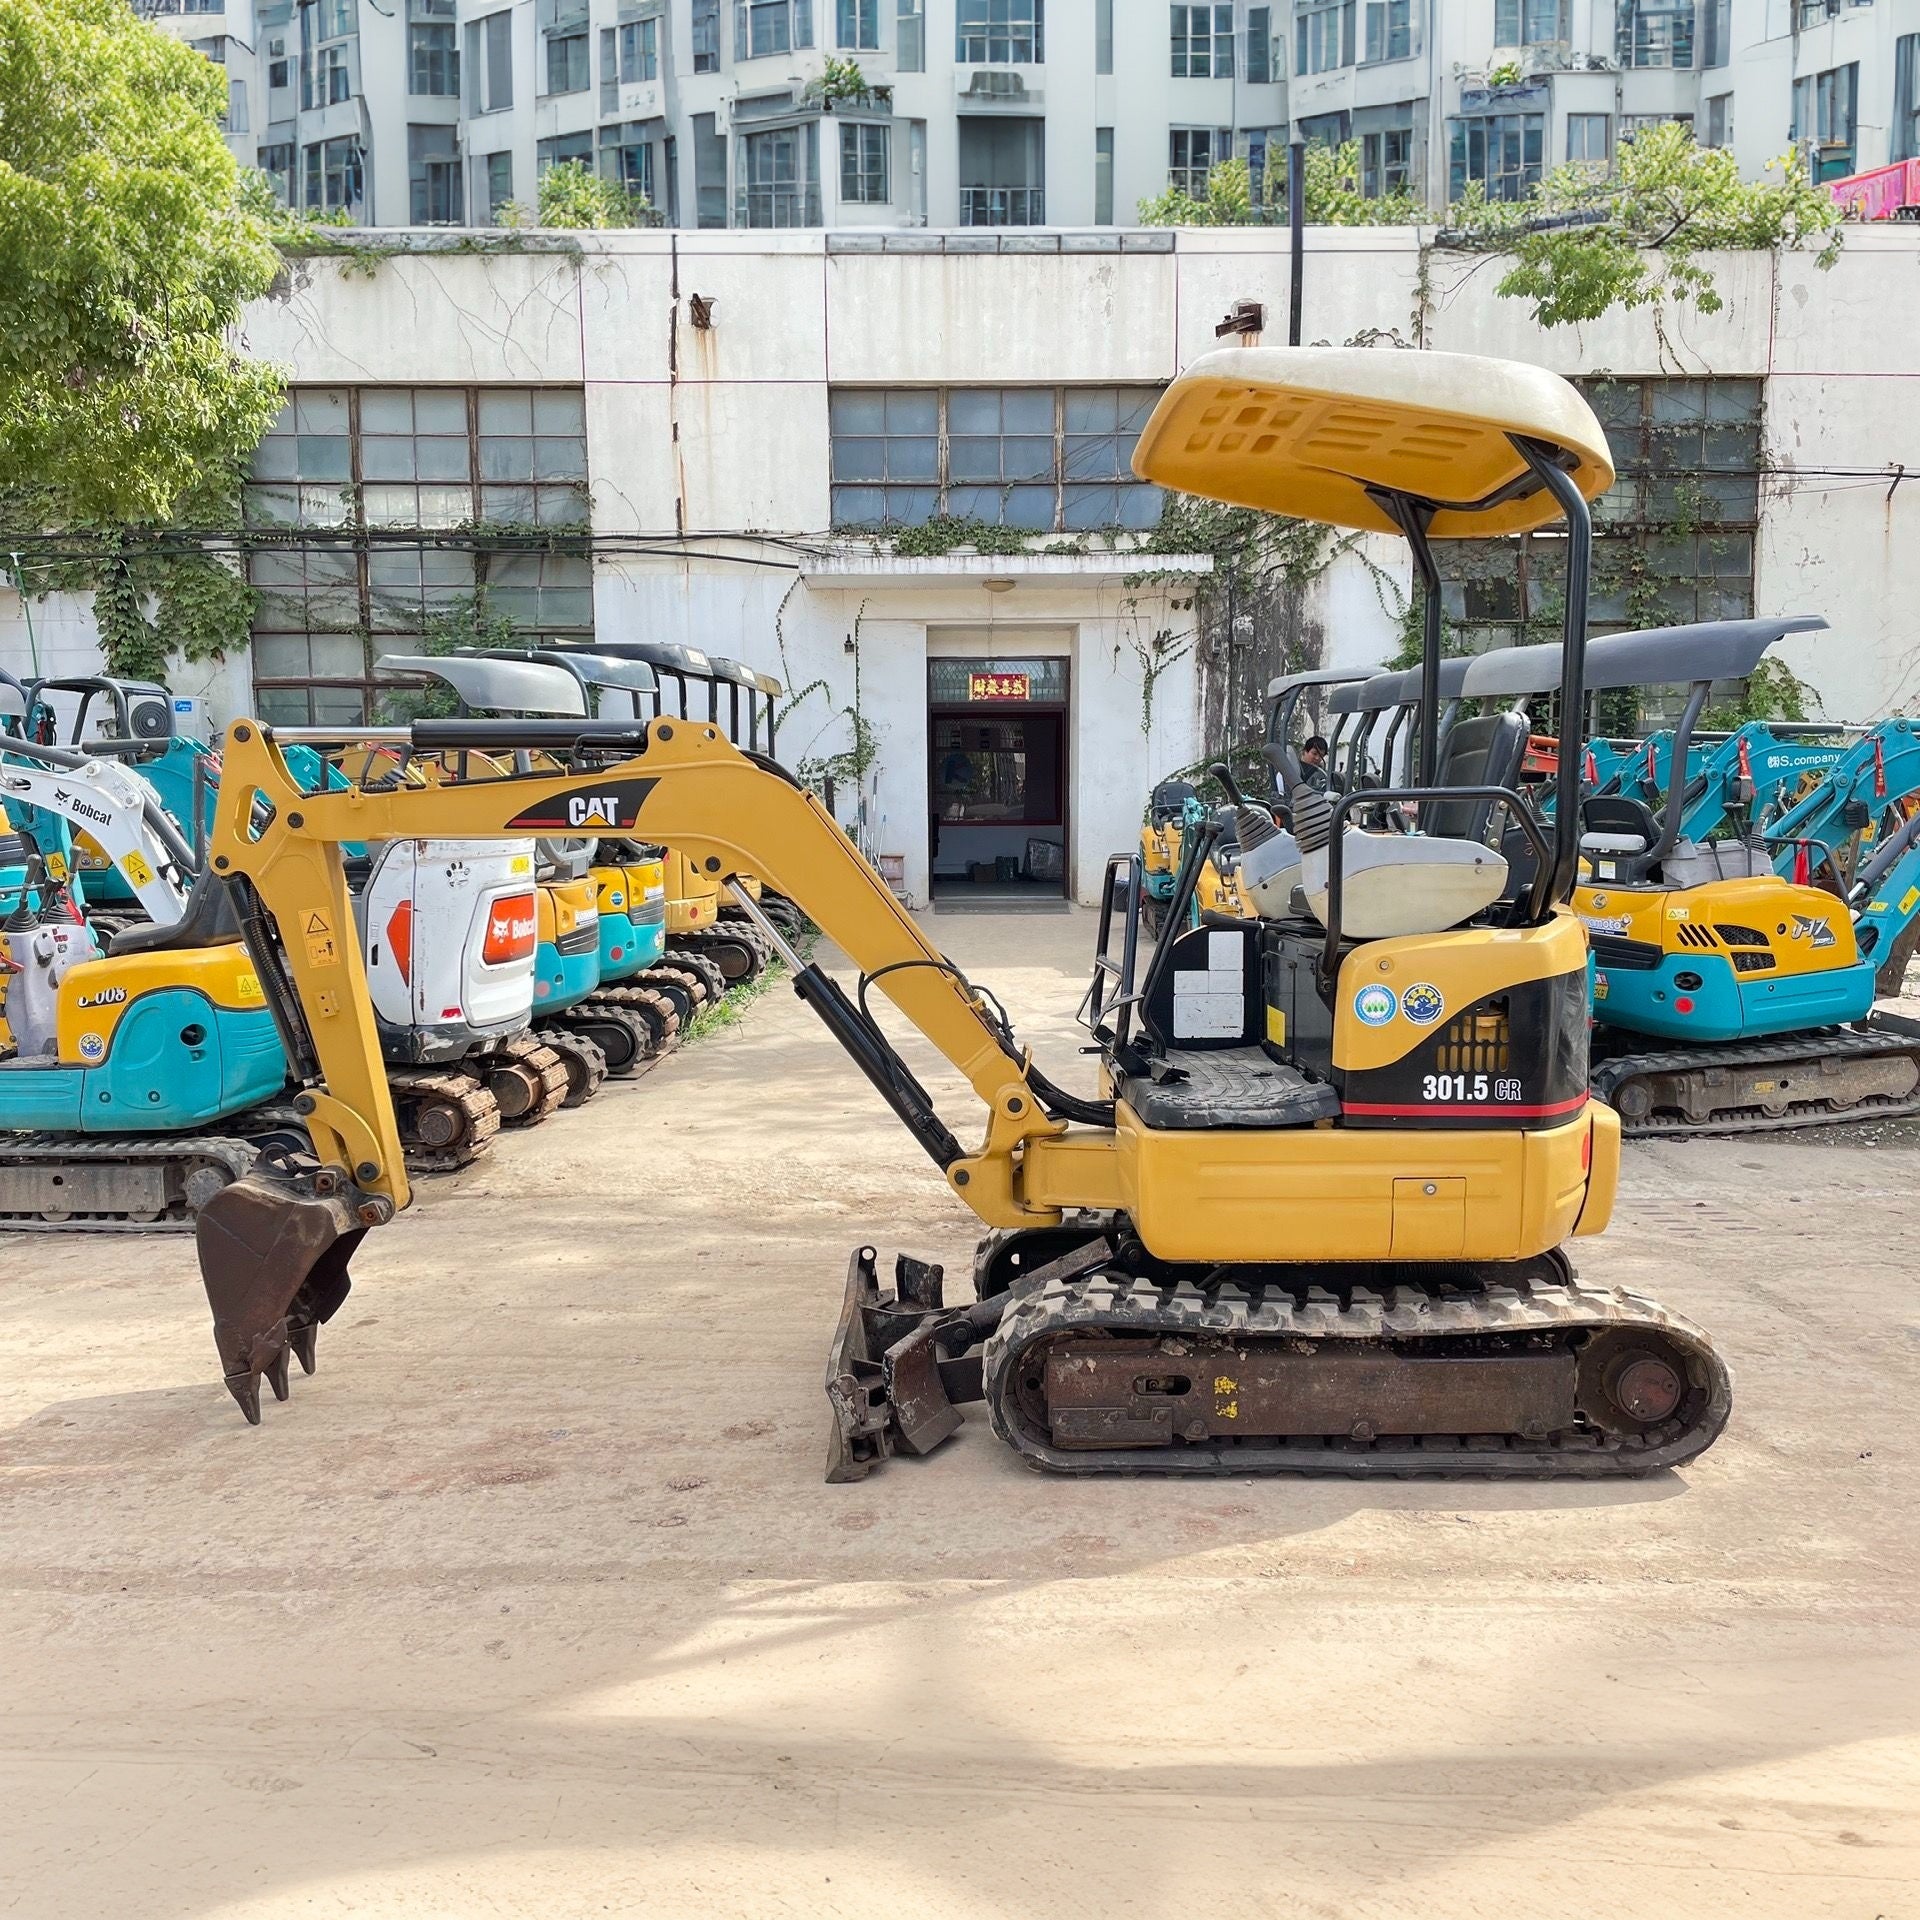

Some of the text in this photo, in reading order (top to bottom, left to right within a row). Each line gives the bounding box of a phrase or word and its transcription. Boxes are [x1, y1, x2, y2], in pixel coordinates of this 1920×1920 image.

[71, 798, 112, 826] Bobcat
[568, 797, 619, 826] CAT
[1422, 1075, 1522, 1101] 301.5 CR
